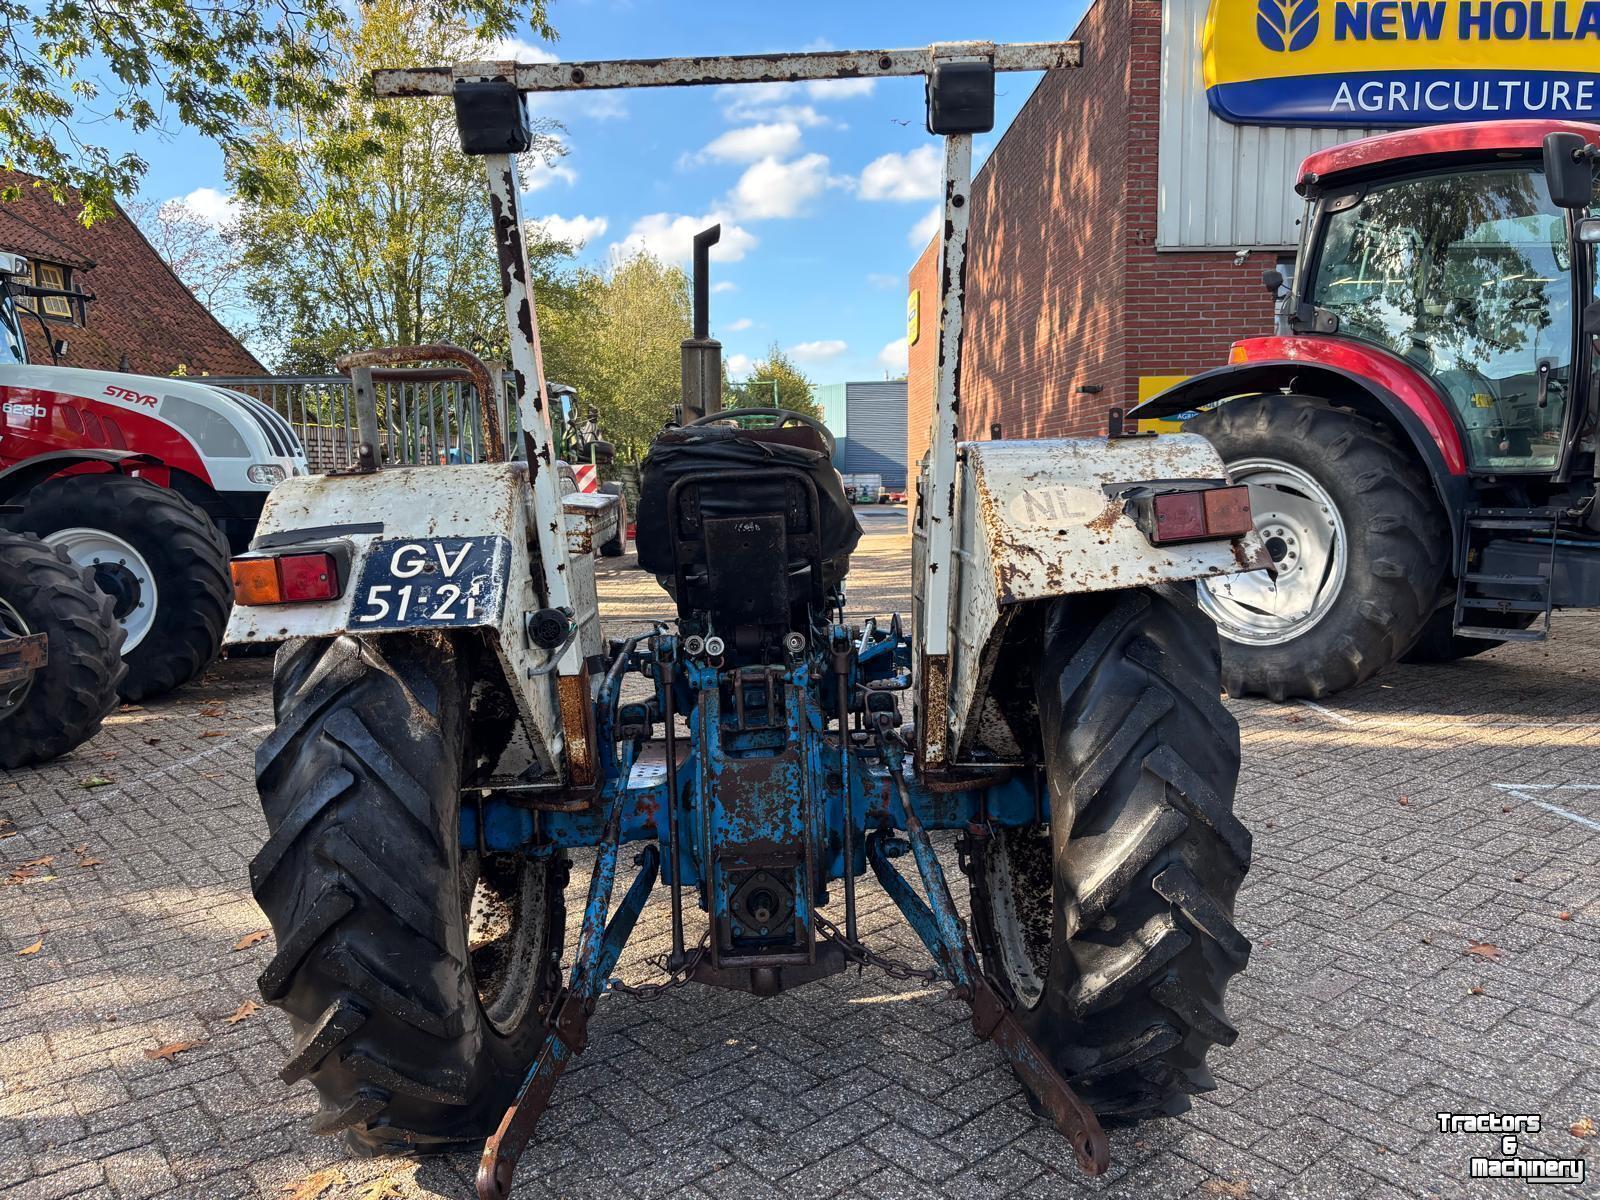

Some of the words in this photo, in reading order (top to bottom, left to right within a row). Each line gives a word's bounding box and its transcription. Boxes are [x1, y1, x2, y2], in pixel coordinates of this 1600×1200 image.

[1334, 1, 1447, 41] NEW
[1329, 81, 1594, 112] AGRICULTURE
[3, 402, 47, 417] 6230
[102, 385, 158, 408] STEYR
[1022, 489, 1086, 523] NL
[390, 542, 473, 579] GV
[360, 583, 481, 622] 51-21
